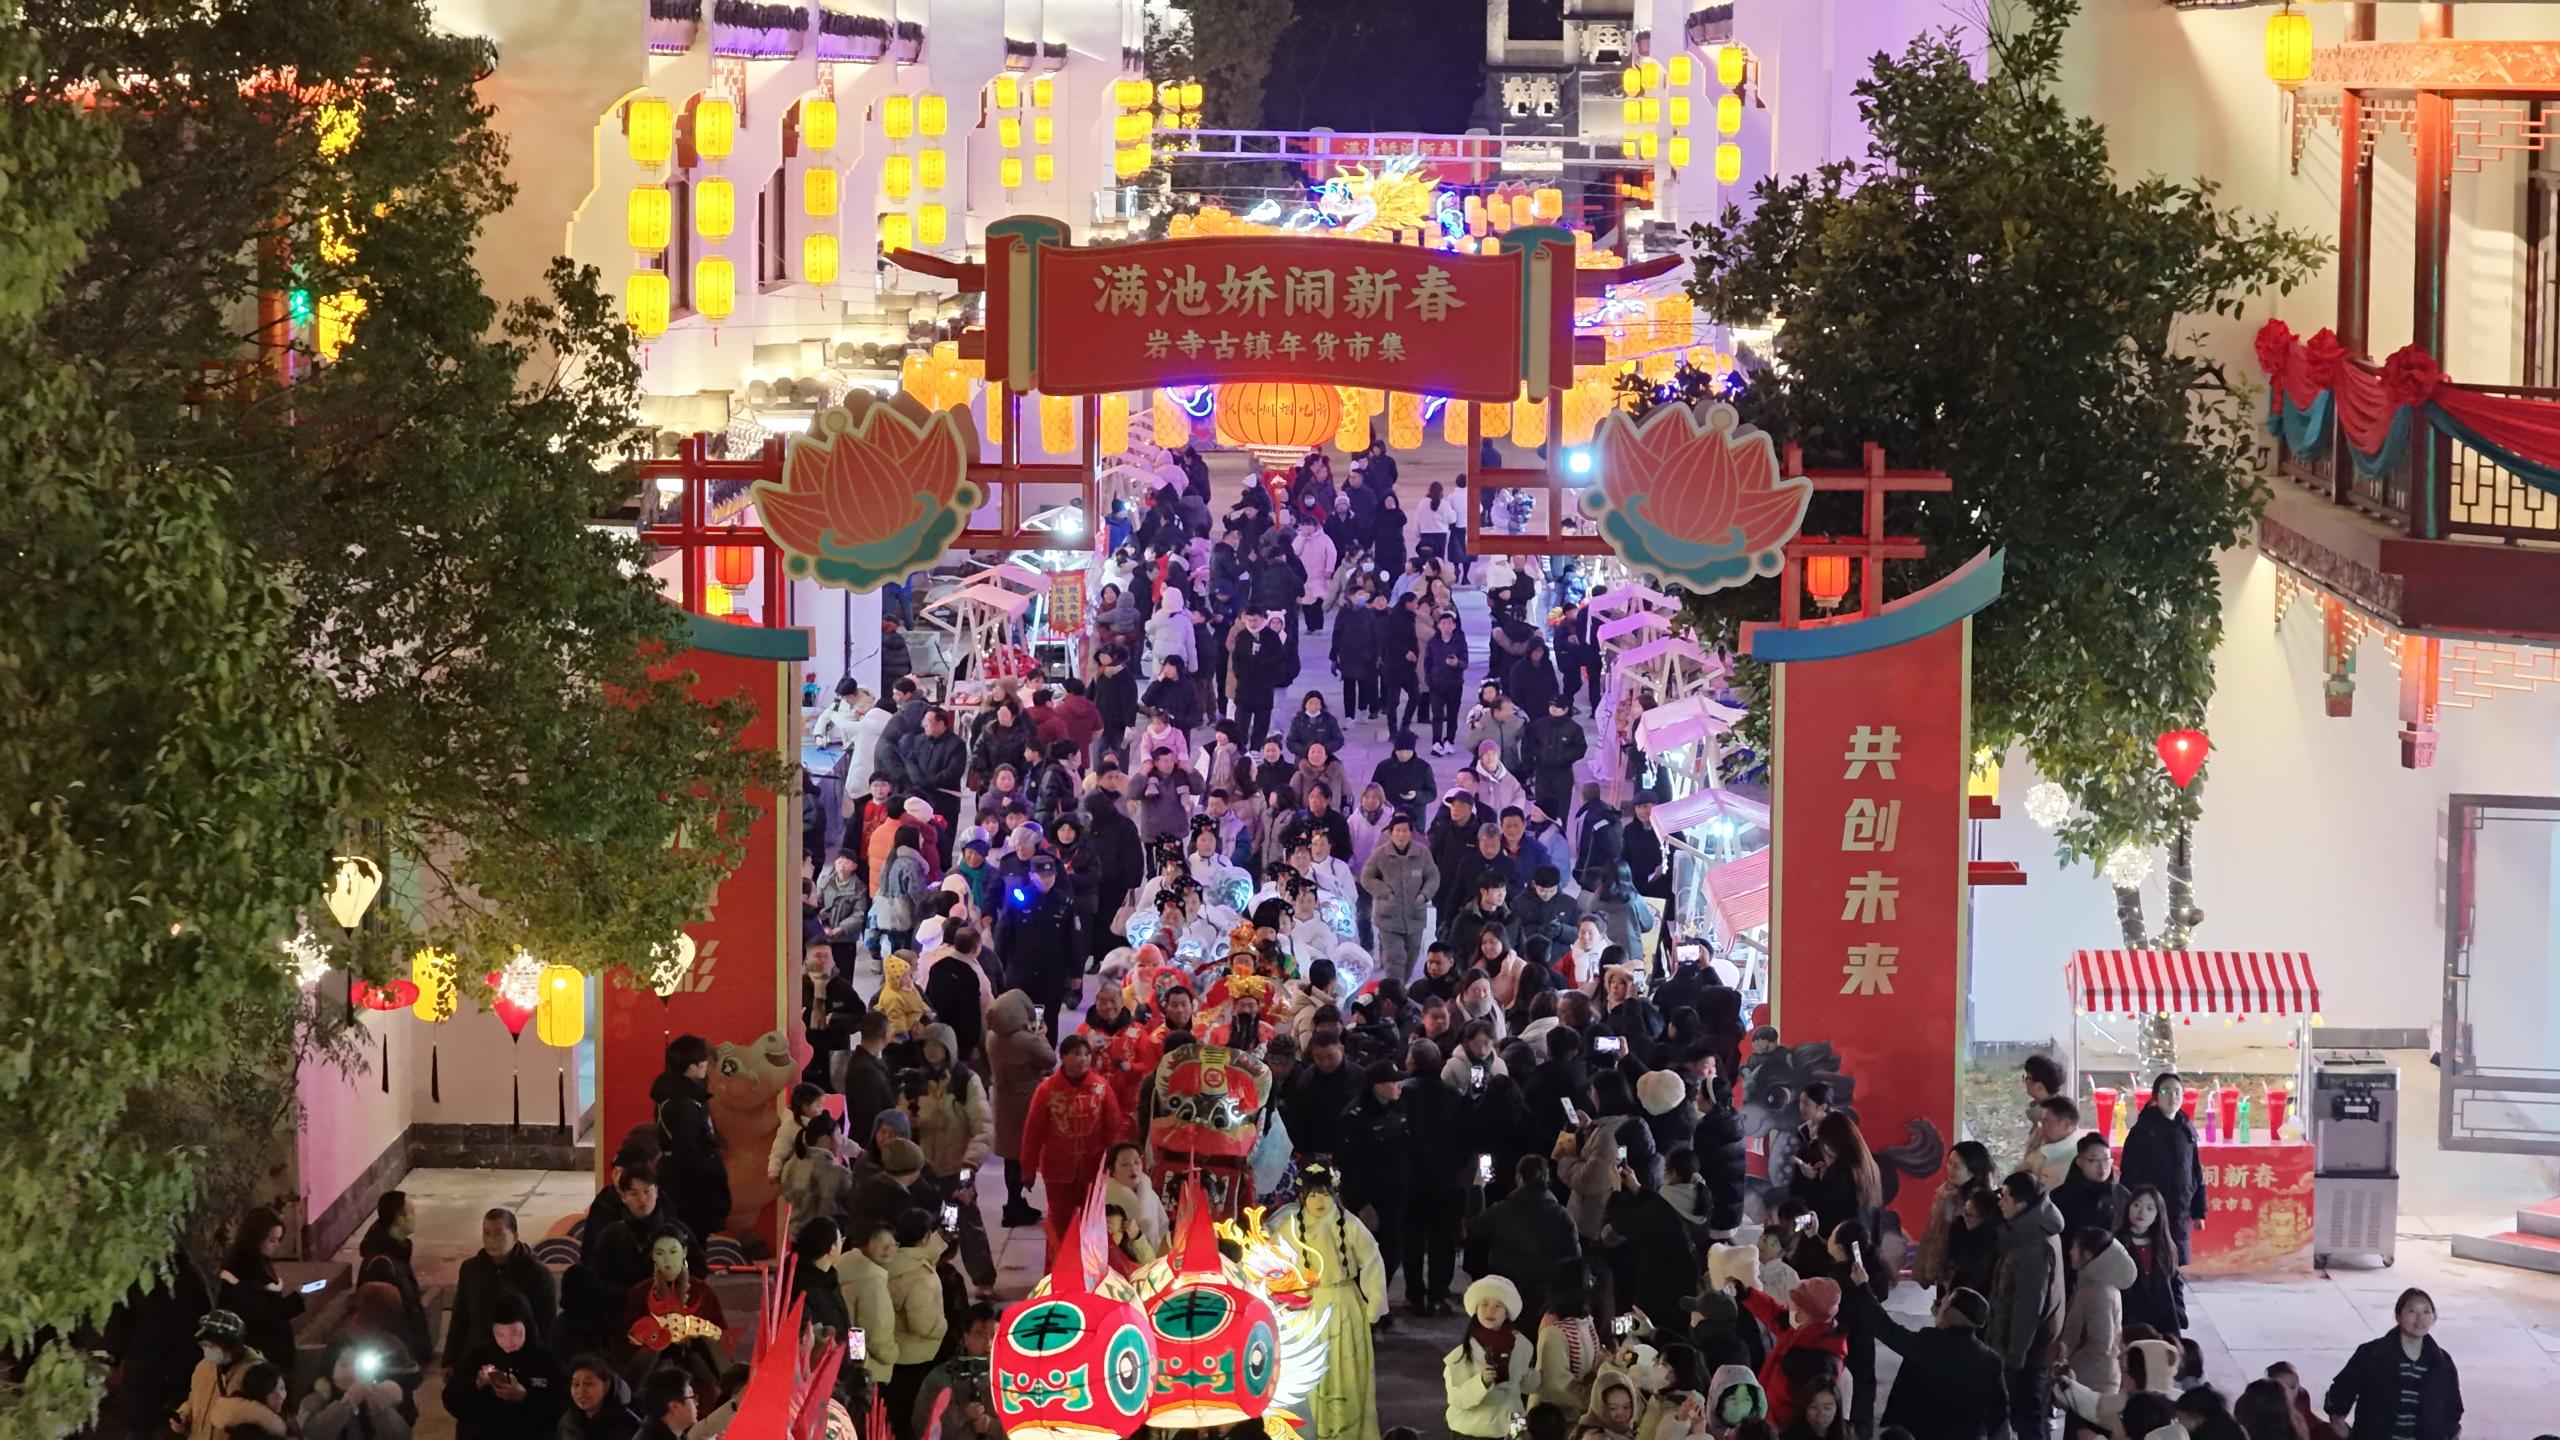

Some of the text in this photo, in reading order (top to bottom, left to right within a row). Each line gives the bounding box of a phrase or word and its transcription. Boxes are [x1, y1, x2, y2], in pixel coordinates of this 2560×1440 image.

[1093, 263, 1466, 322] 满池娇闹新春
[1143, 329, 1407, 362] 岩寺古镇年货市集
[1839, 725, 1901, 996] 共创未来
